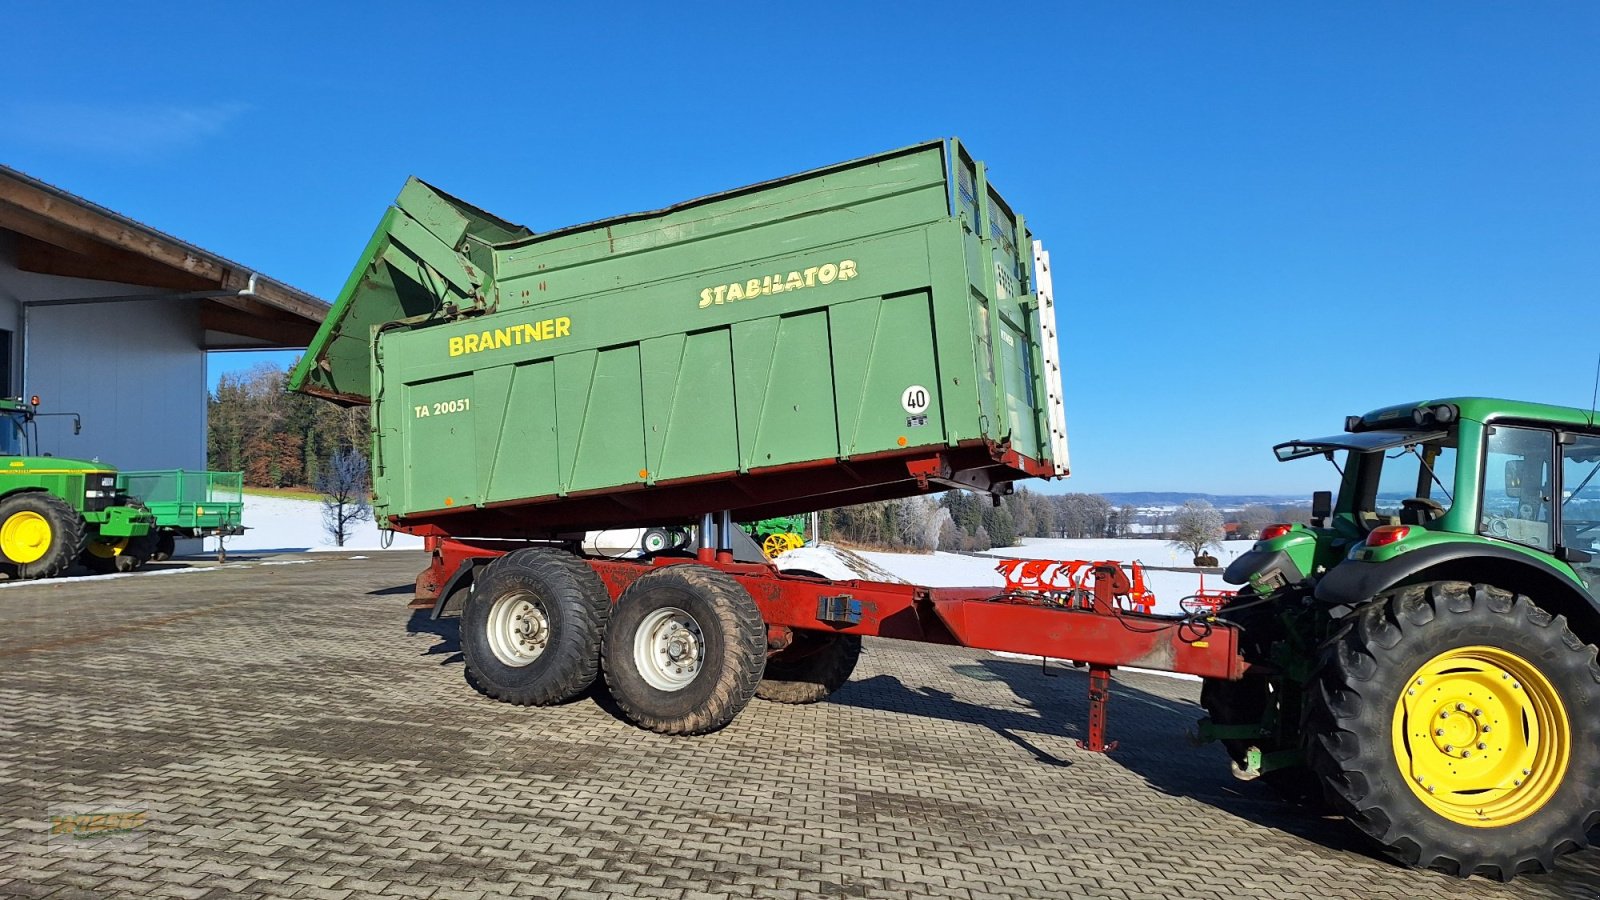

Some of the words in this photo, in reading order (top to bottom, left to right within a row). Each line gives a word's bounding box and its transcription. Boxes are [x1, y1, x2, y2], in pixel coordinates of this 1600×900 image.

[698, 259, 859, 310] STABILATOR
[448, 316, 572, 358] BRANTNER
[414, 405, 430, 418] TA
[433, 398, 470, 416] 20051
[907, 389, 926, 409] 40
